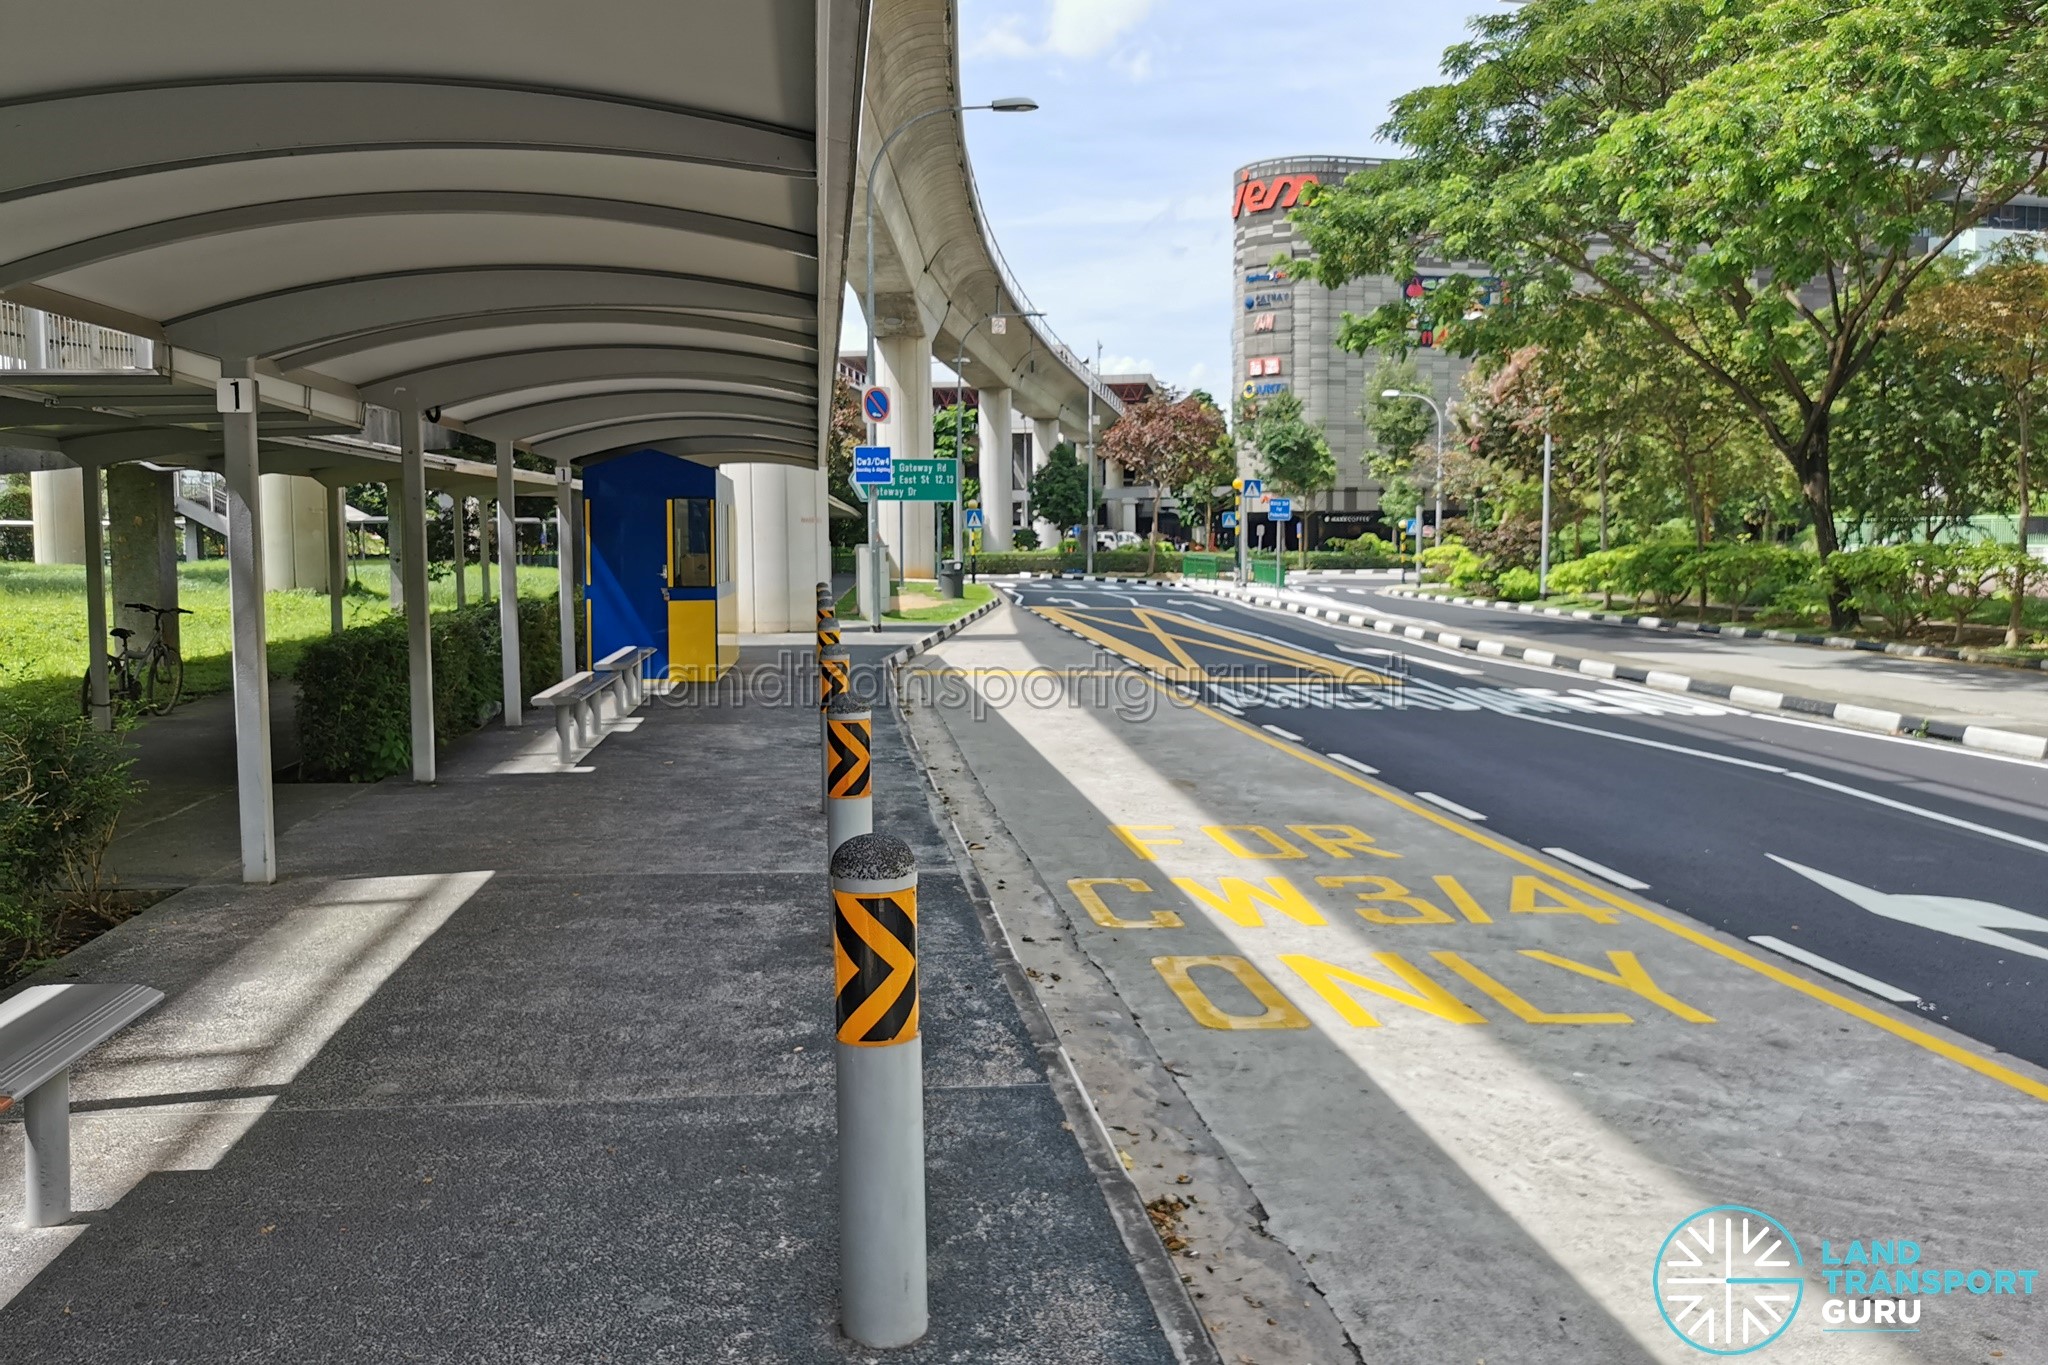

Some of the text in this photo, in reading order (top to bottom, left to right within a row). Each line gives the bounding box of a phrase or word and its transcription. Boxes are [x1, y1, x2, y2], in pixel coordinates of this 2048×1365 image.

[1232, 169, 1319, 218] jem
[230, 381, 240, 410] 1
[856, 457, 889, 466] Cw3/Cw4
[561, 468, 566, 481] 1
[899, 463, 933, 475] Gateway
[937, 463, 947, 472] Rd
[899, 475, 917, 484] East
[920, 475, 930, 484] St
[876, 486, 917, 498] ateway Dr
[1110, 824, 1404, 860] FOR
[1151, 951, 1717, 1030] ONLY
